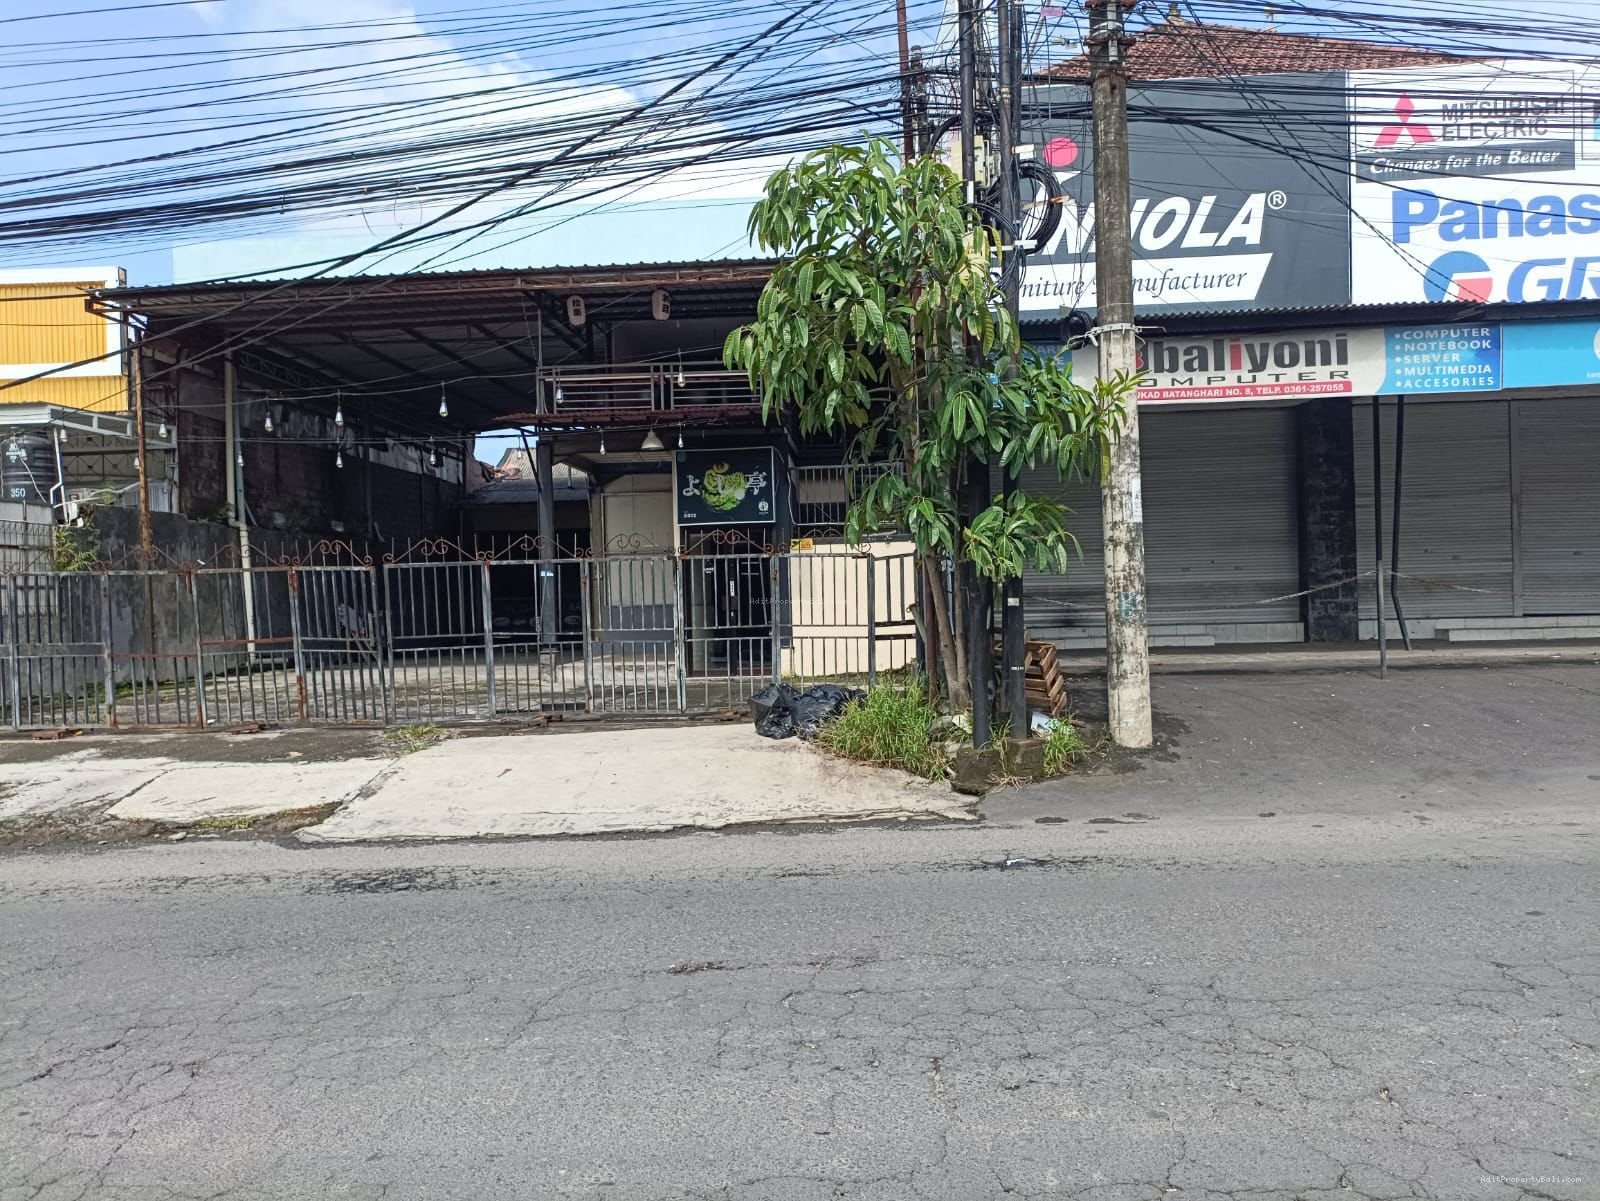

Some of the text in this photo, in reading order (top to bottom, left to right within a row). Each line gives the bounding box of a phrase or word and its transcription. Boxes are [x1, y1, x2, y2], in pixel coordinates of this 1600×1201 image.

[1442, 117, 1548, 142] ELECTRIC
[1370, 149, 1560, 174] Changes for the Better
[1020, 267, 1248, 298] niture nufacturer
[1403, 327, 1491, 340] COMPUTER
[1404, 339, 1492, 352] NOTEBOOK
[1153, 332, 1349, 374] baliyoni
[1403, 352, 1461, 364] SERVER
[1404, 364, 1492, 376] MULTIMEDIA
[1138, 370, 1349, 387] OMPUTER
[1404, 376, 1494, 389] ACCESORIES
[1163, 388, 1223, 399] BATANGHARI
[1226, 387, 1243, 396] NO.
[1284, 383, 1344, 394] 0361-257055
[10, 487, 26, 498] 350
